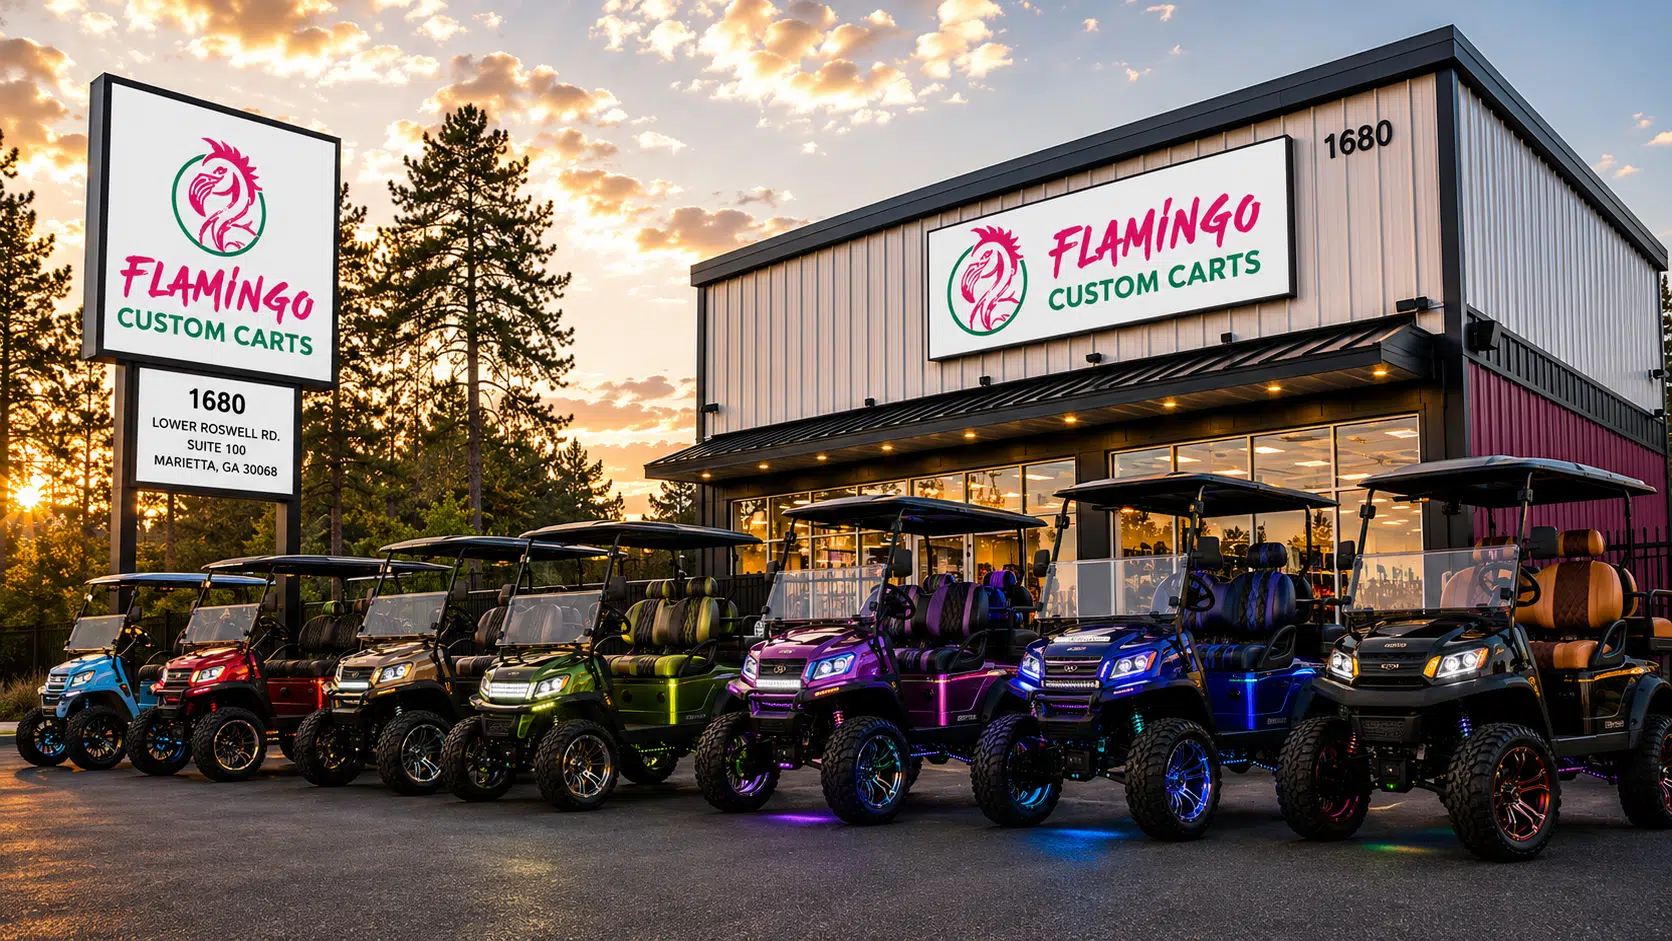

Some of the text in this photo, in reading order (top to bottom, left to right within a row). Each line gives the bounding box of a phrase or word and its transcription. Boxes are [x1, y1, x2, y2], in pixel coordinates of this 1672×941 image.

[1324, 119, 1393, 160] 1680
[1048, 249, 1262, 312] CUSTOM CARTS
[117, 306, 313, 357] CUSTOM CARTS
[189, 387, 246, 415] 1680
[152, 416, 281, 442] LOWER ROSWELL RD.
[187, 439, 247, 456] SUITE 100
[154, 454, 278, 477] MARIETTA, GA 30068
